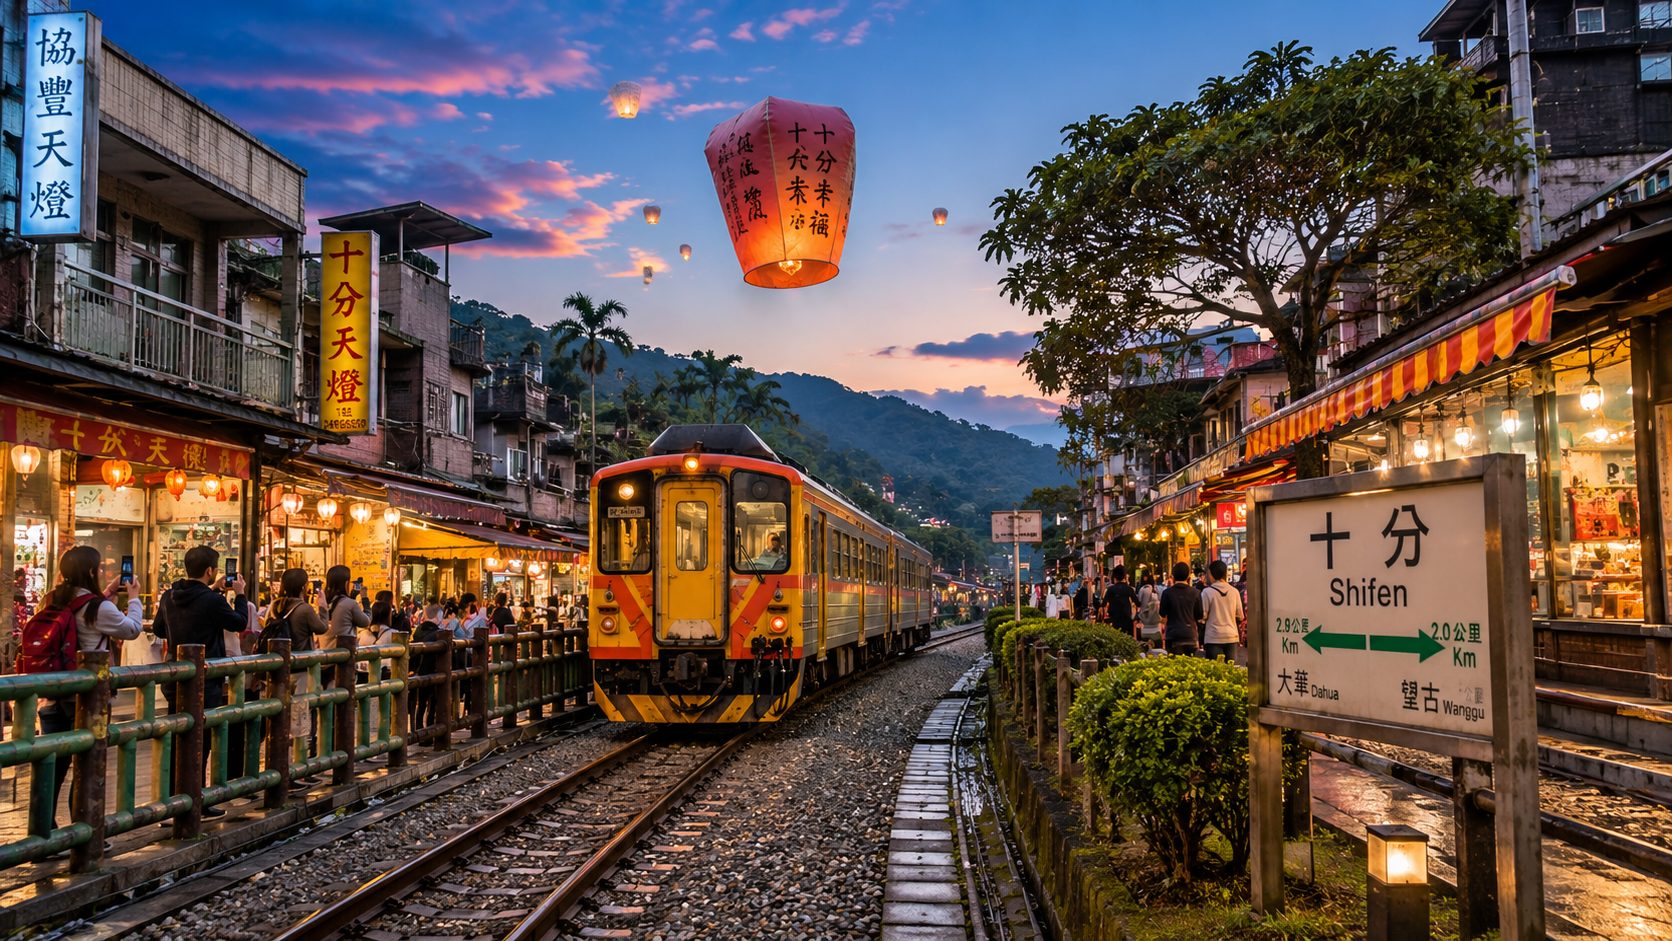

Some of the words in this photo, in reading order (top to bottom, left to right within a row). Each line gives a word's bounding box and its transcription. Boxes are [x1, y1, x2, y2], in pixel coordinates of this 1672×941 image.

[30, 28, 76, 220] 協豐天燈
[326, 239, 364, 404] 十分天燈
[1309, 503, 1430, 570] 十分
[1329, 577, 1408, 608] Shifen
[1281, 636, 1299, 655] Km
[1453, 646, 1477, 668] Km
[1277, 667, 1309, 697] 大華
[1311, 684, 1340, 701] Dahua
[1401, 679, 1440, 714] 望古
[1442, 699, 1485, 722] Wanggu
